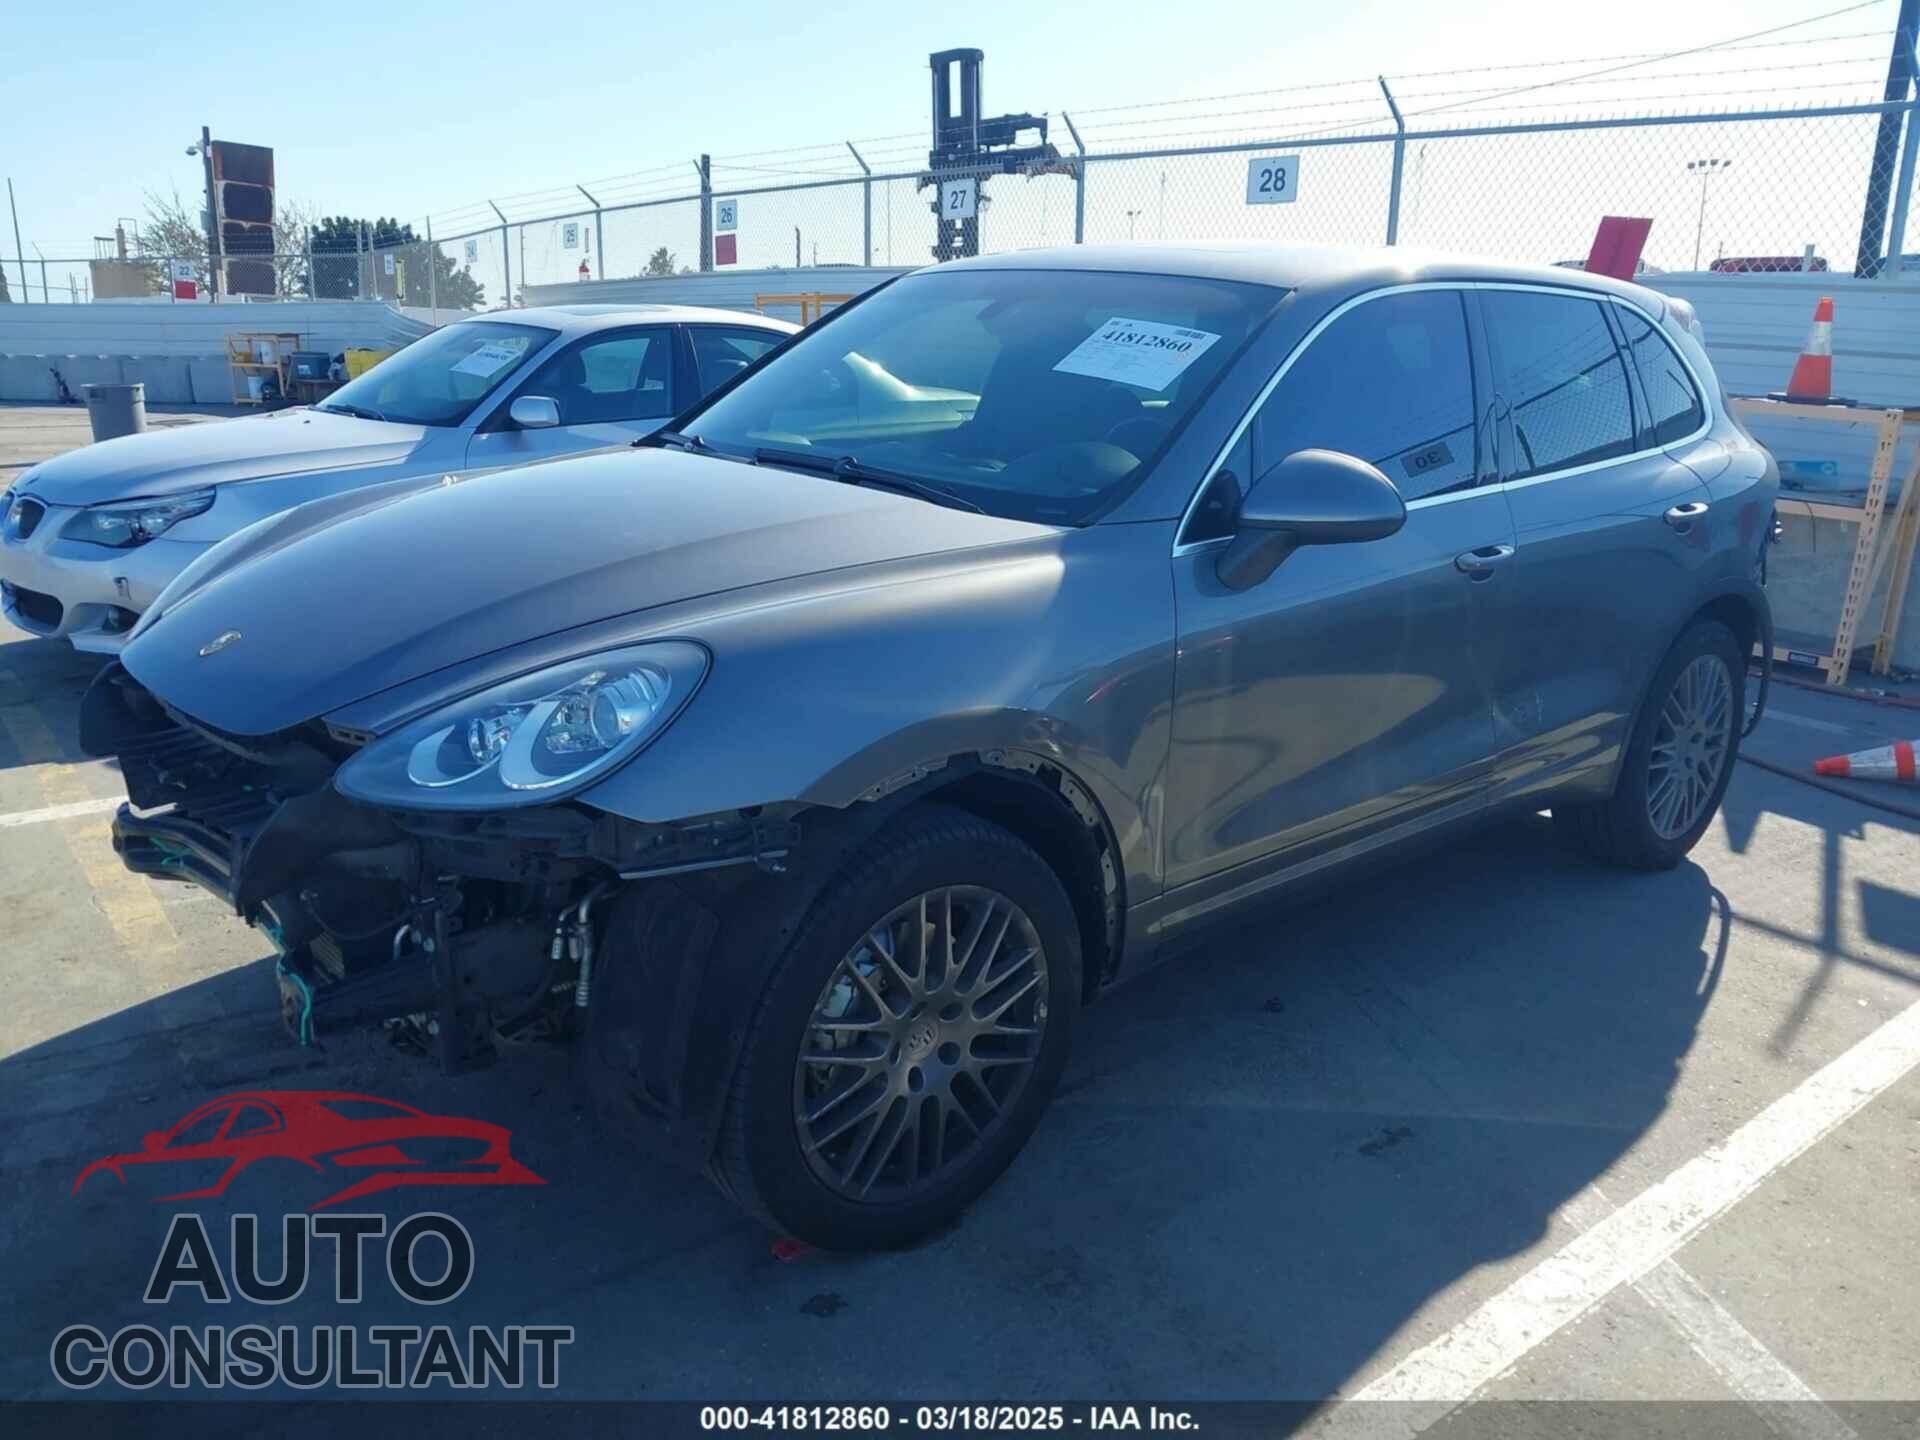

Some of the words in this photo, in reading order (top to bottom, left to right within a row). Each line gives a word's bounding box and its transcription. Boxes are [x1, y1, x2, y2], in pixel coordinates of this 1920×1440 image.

[1259, 168, 1286, 192] 28
[950, 190, 967, 209] 27
[720, 207, 733, 224] 26
[1102, 331, 1193, 352] 41812860
